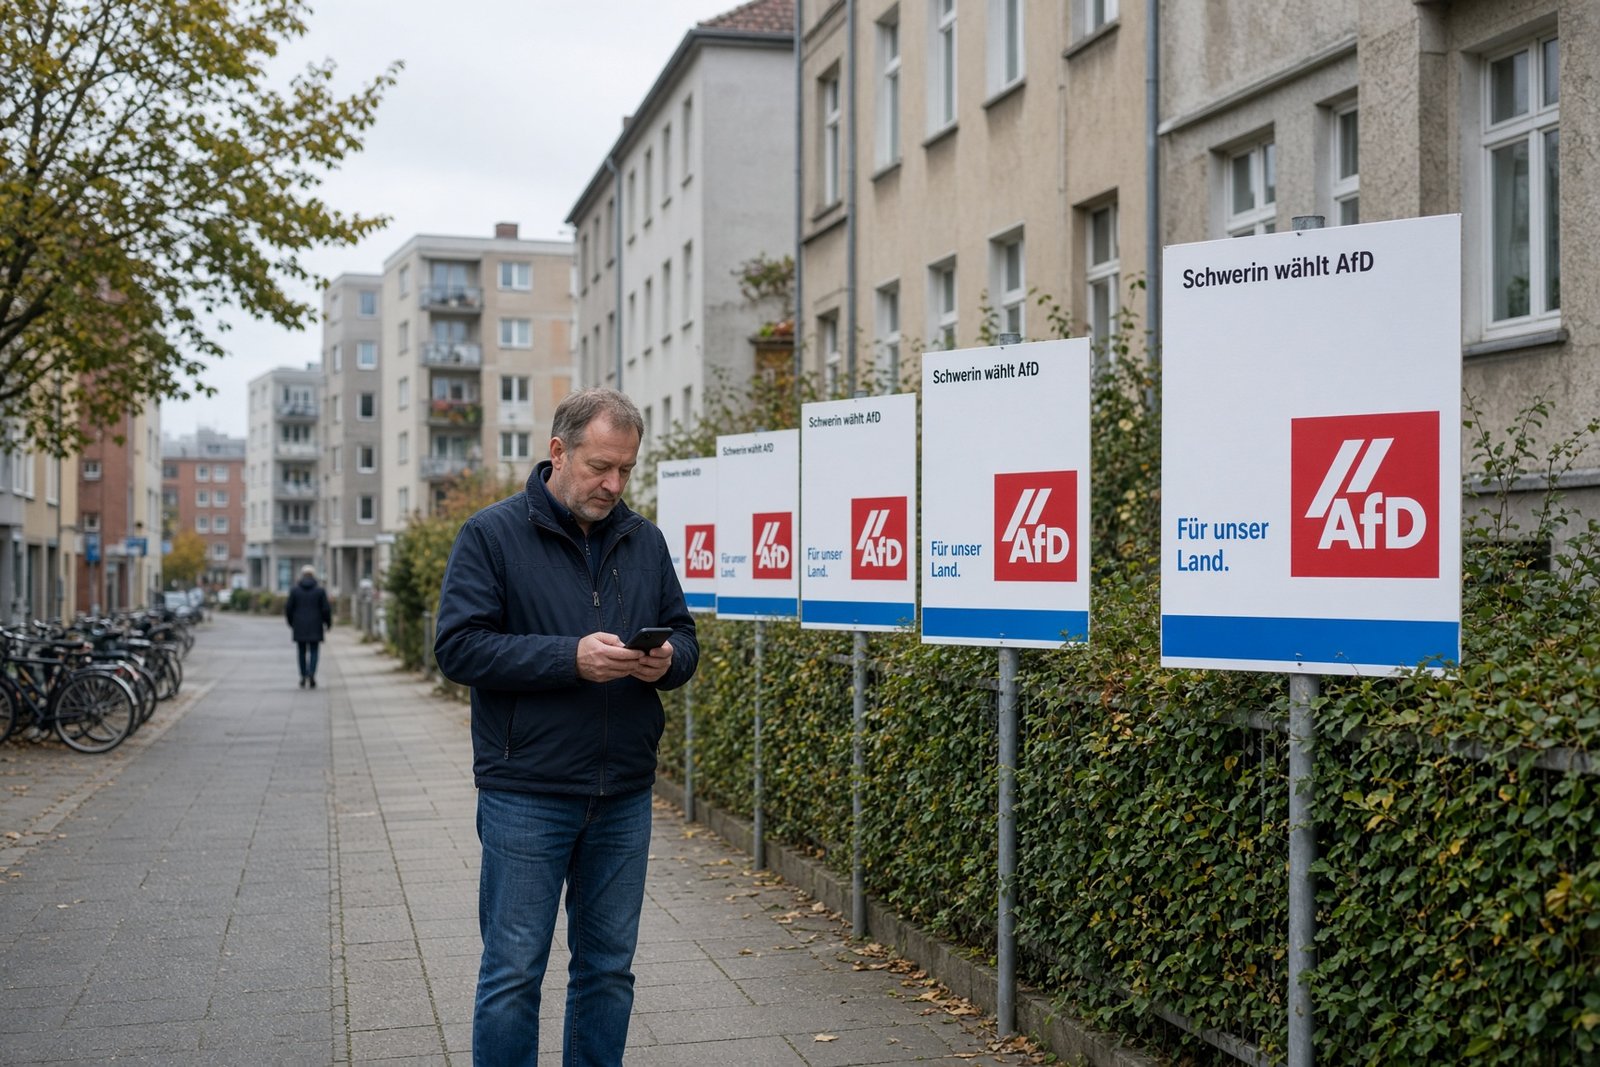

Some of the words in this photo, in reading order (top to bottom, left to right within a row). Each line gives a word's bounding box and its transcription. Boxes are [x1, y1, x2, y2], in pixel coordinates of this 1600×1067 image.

[1182, 261, 1269, 288] Schwerin
[1274, 254, 1330, 279] wählt
[1335, 250, 1374, 275] AfD
[932, 366, 982, 385] Schwerin
[984, 363, 1016, 381] wählt
[1018, 361, 1040, 378] AfD
[808, 415, 842, 428] Schwerin
[843, 412, 864, 425] wählt
[866, 411, 881, 424] AfD
[1177, 517, 1209, 540] Für
[1213, 521, 1269, 540] unser
[1317, 492, 1427, 549] AfD
[821, 550, 843, 560] unser
[860, 536, 902, 567] AfD
[931, 541, 949, 557] Für
[951, 544, 982, 557] unser
[1008, 524, 1070, 563] AfD
[689, 549, 714, 570] AfD
[758, 543, 790, 569] AfD
[1177, 549, 1230, 572] Land.
[807, 565, 829, 577] Land.
[931, 562, 961, 578] Land.
